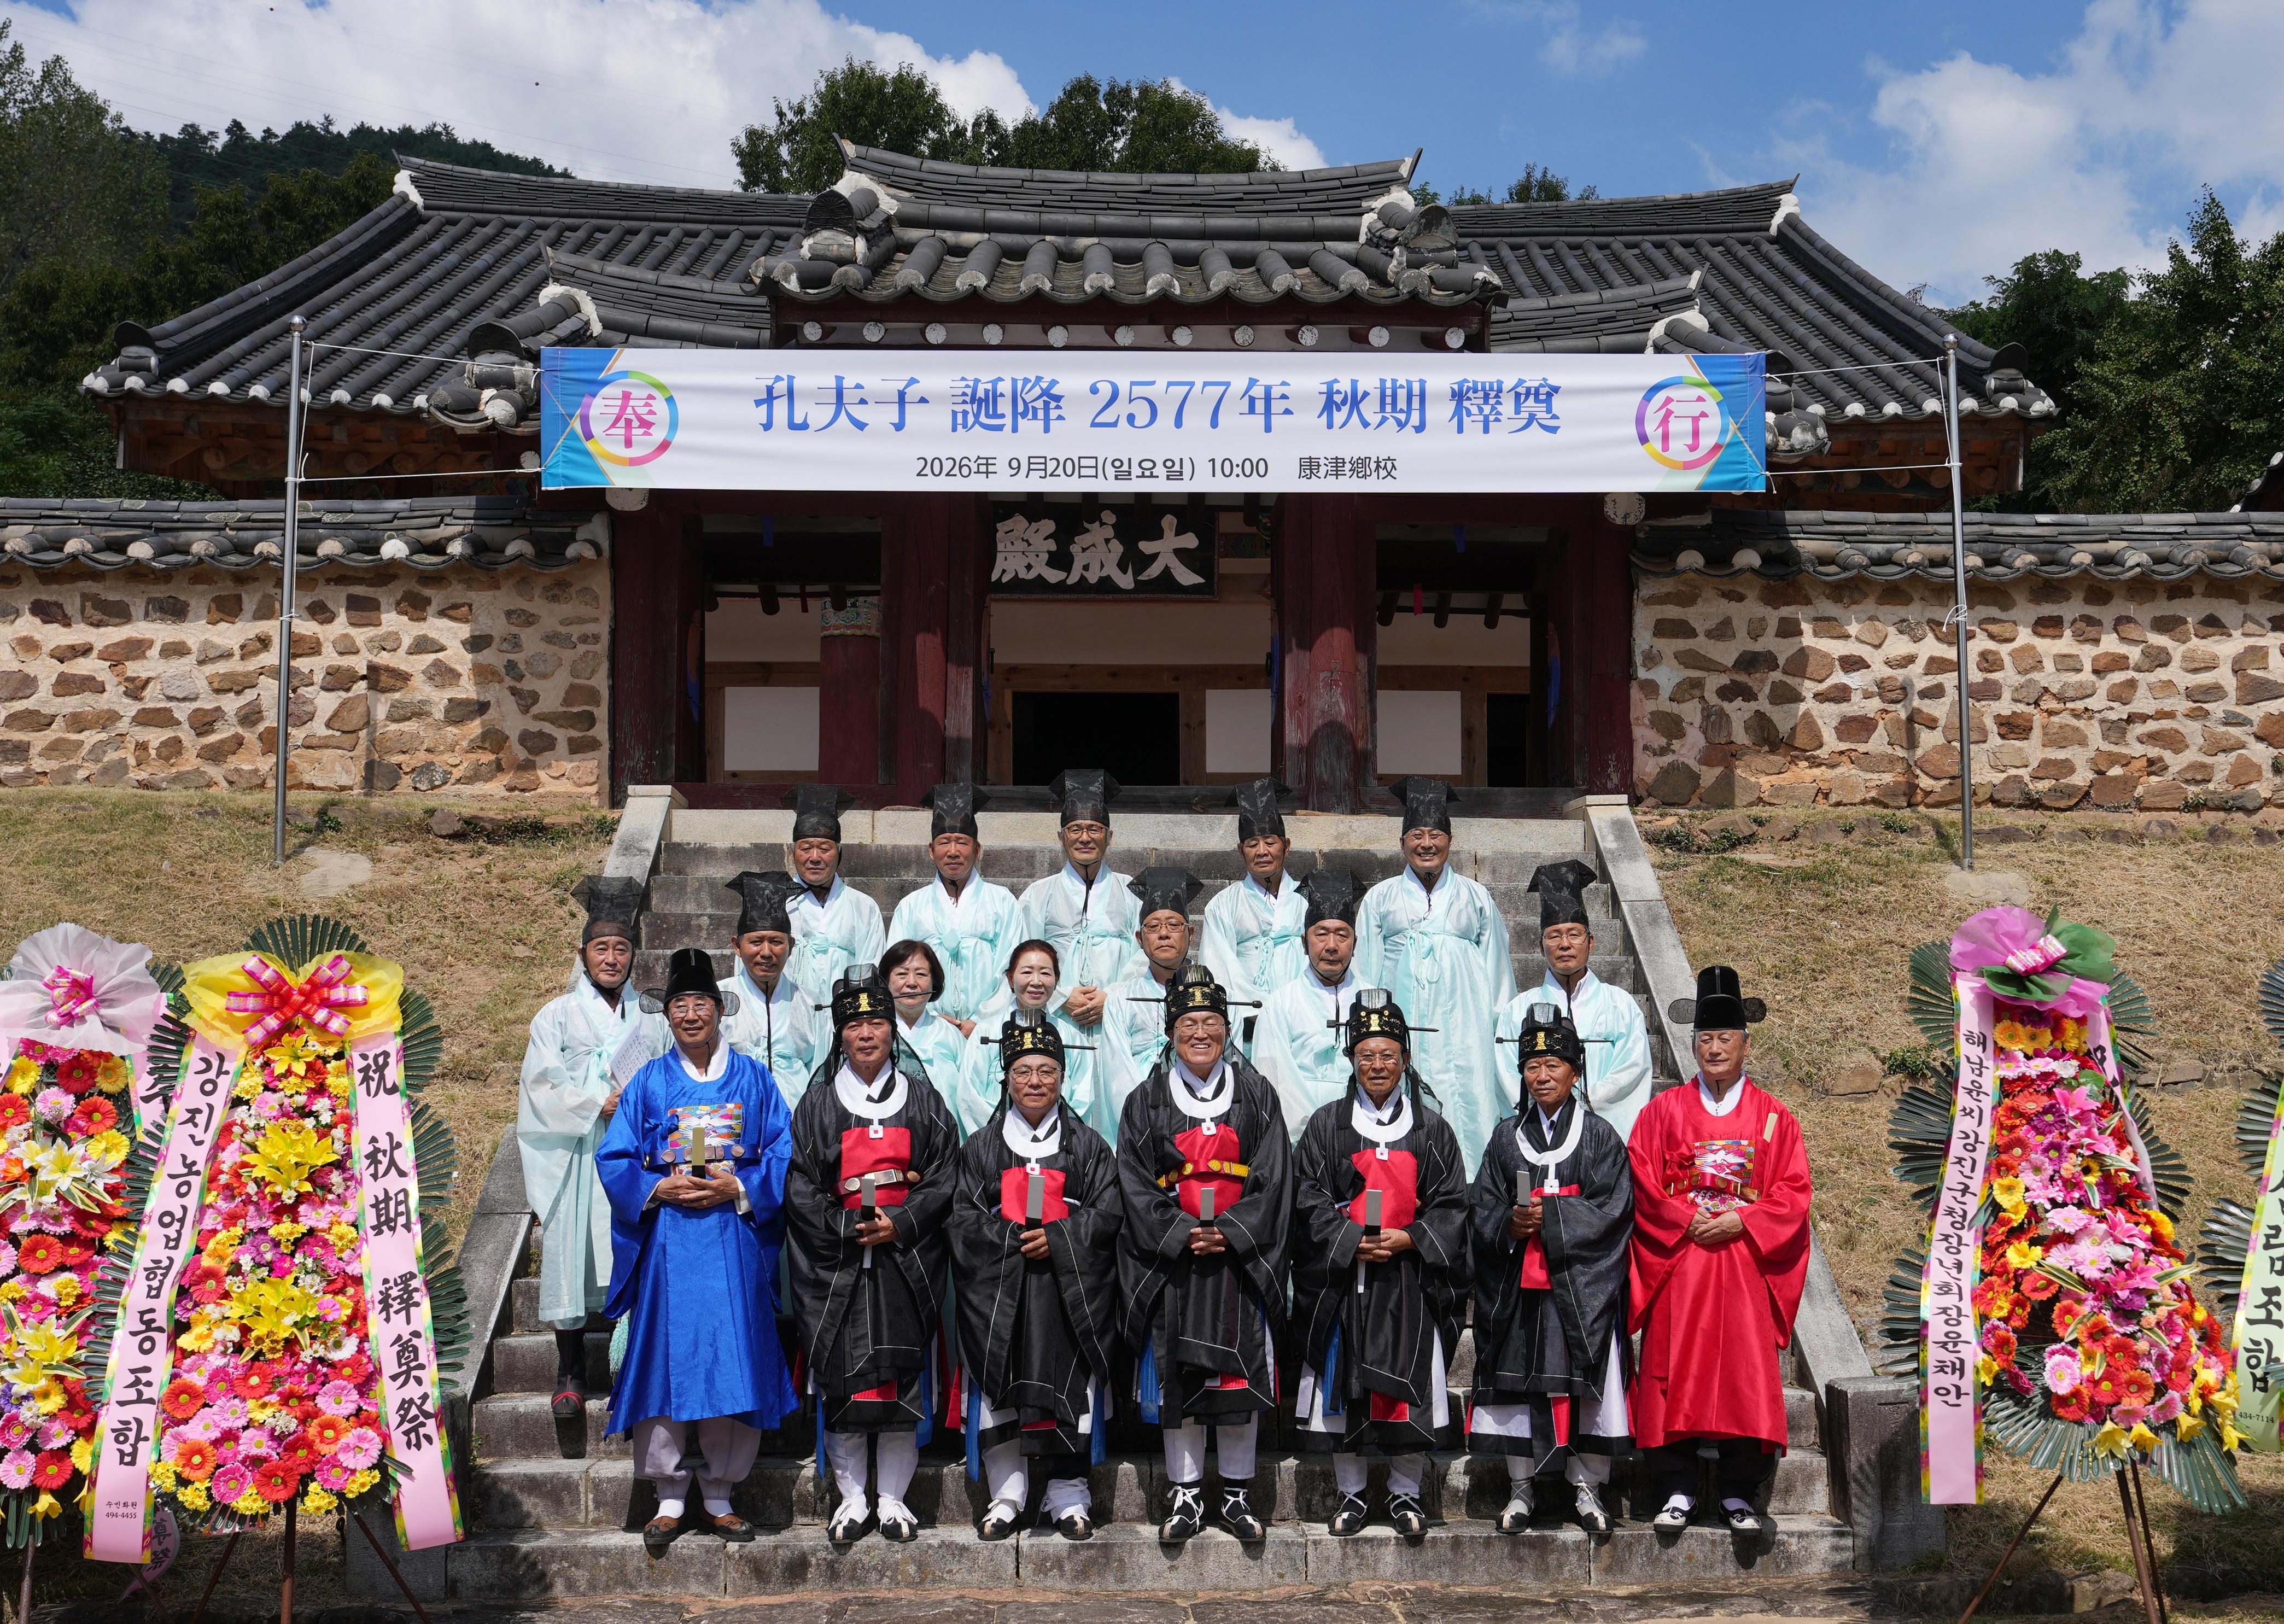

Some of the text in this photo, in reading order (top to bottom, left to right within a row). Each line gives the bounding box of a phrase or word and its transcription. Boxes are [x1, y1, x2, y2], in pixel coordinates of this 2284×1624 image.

[600, 390, 657, 450] 奉
[753, 375, 1562, 435] 孔夫子 誕降 2577年 秋期 釋奠
[1653, 395, 1709, 453] 行
[916, 455, 997, 479] 2026年
[1208, 458, 1269, 478] 10:00
[110, 1051, 230, 1467] 강진농업협동조합
[357, 1049, 436, 1452] 祝 秋期 釋奠祭
[2238, 1411, 2275, 1424] 434-7114
